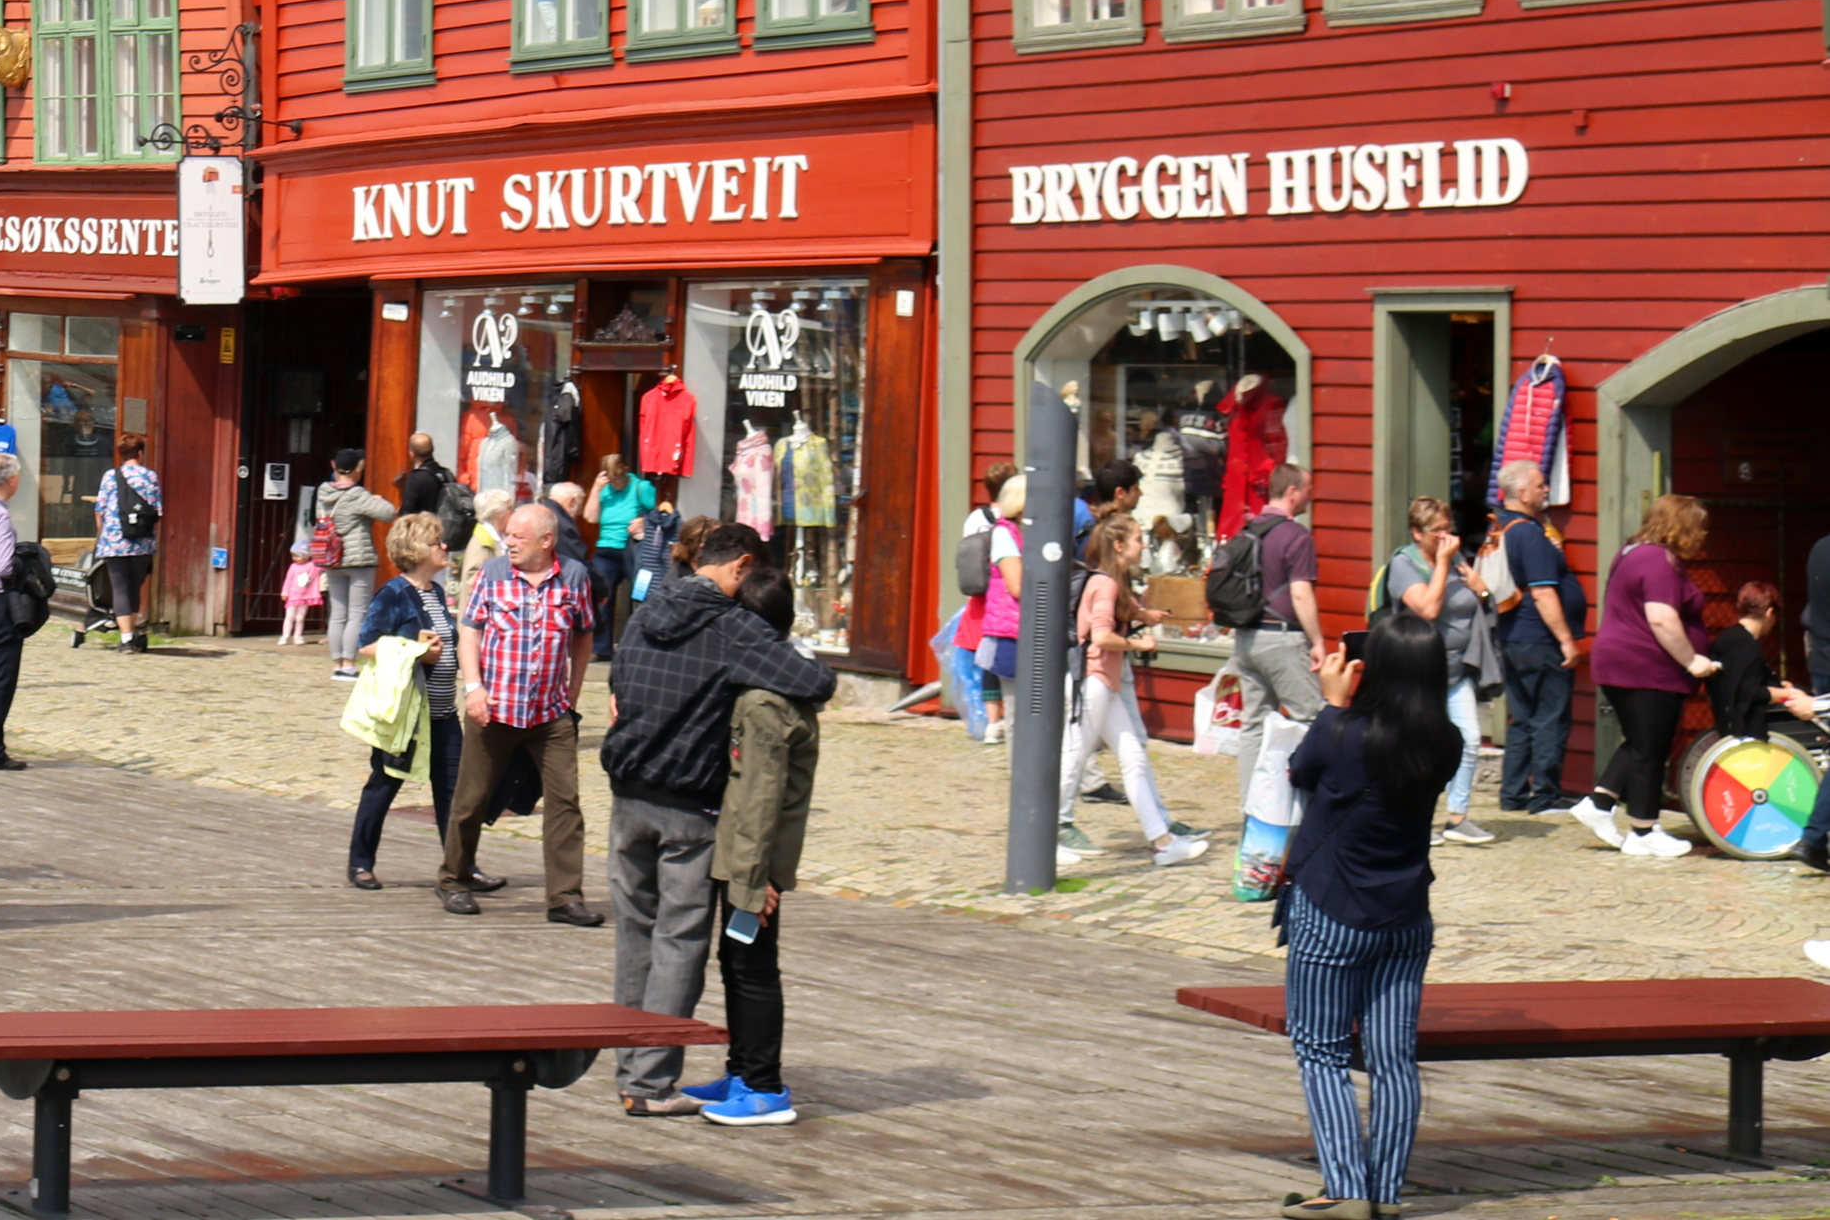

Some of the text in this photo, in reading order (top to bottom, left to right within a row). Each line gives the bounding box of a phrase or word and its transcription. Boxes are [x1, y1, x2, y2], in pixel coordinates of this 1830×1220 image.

[1008, 137, 1530, 225] BRYGGEN HUSFLID
[351, 154, 809, 242] KNUT SKURTVEIT
[466, 371, 515, 388] AUDHILD
[739, 374, 797, 391] AUDHILD
[472, 387, 505, 402] VIKEN
[745, 391, 785, 407] VIKEN
